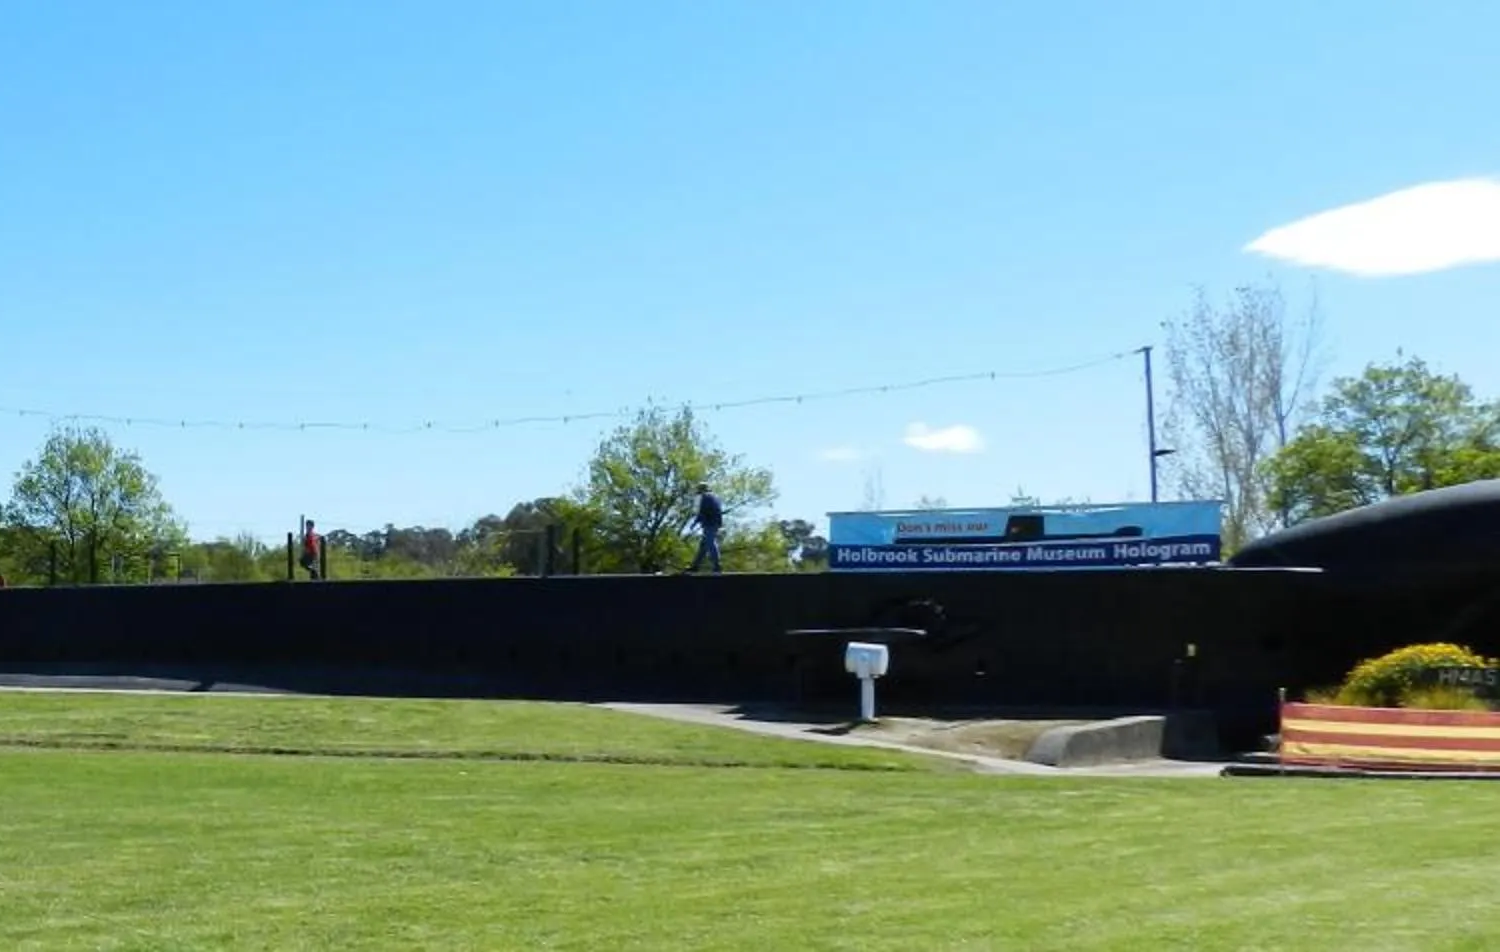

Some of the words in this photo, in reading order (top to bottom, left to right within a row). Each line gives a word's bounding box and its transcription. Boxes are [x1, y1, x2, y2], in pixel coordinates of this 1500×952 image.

[934, 521, 964, 532] miss
[837, 547, 918, 563] Holbrook
[923, 547, 1021, 563] Submarine
[1026, 546, 1106, 561] Museum
[1112, 542, 1212, 560] Hologram
